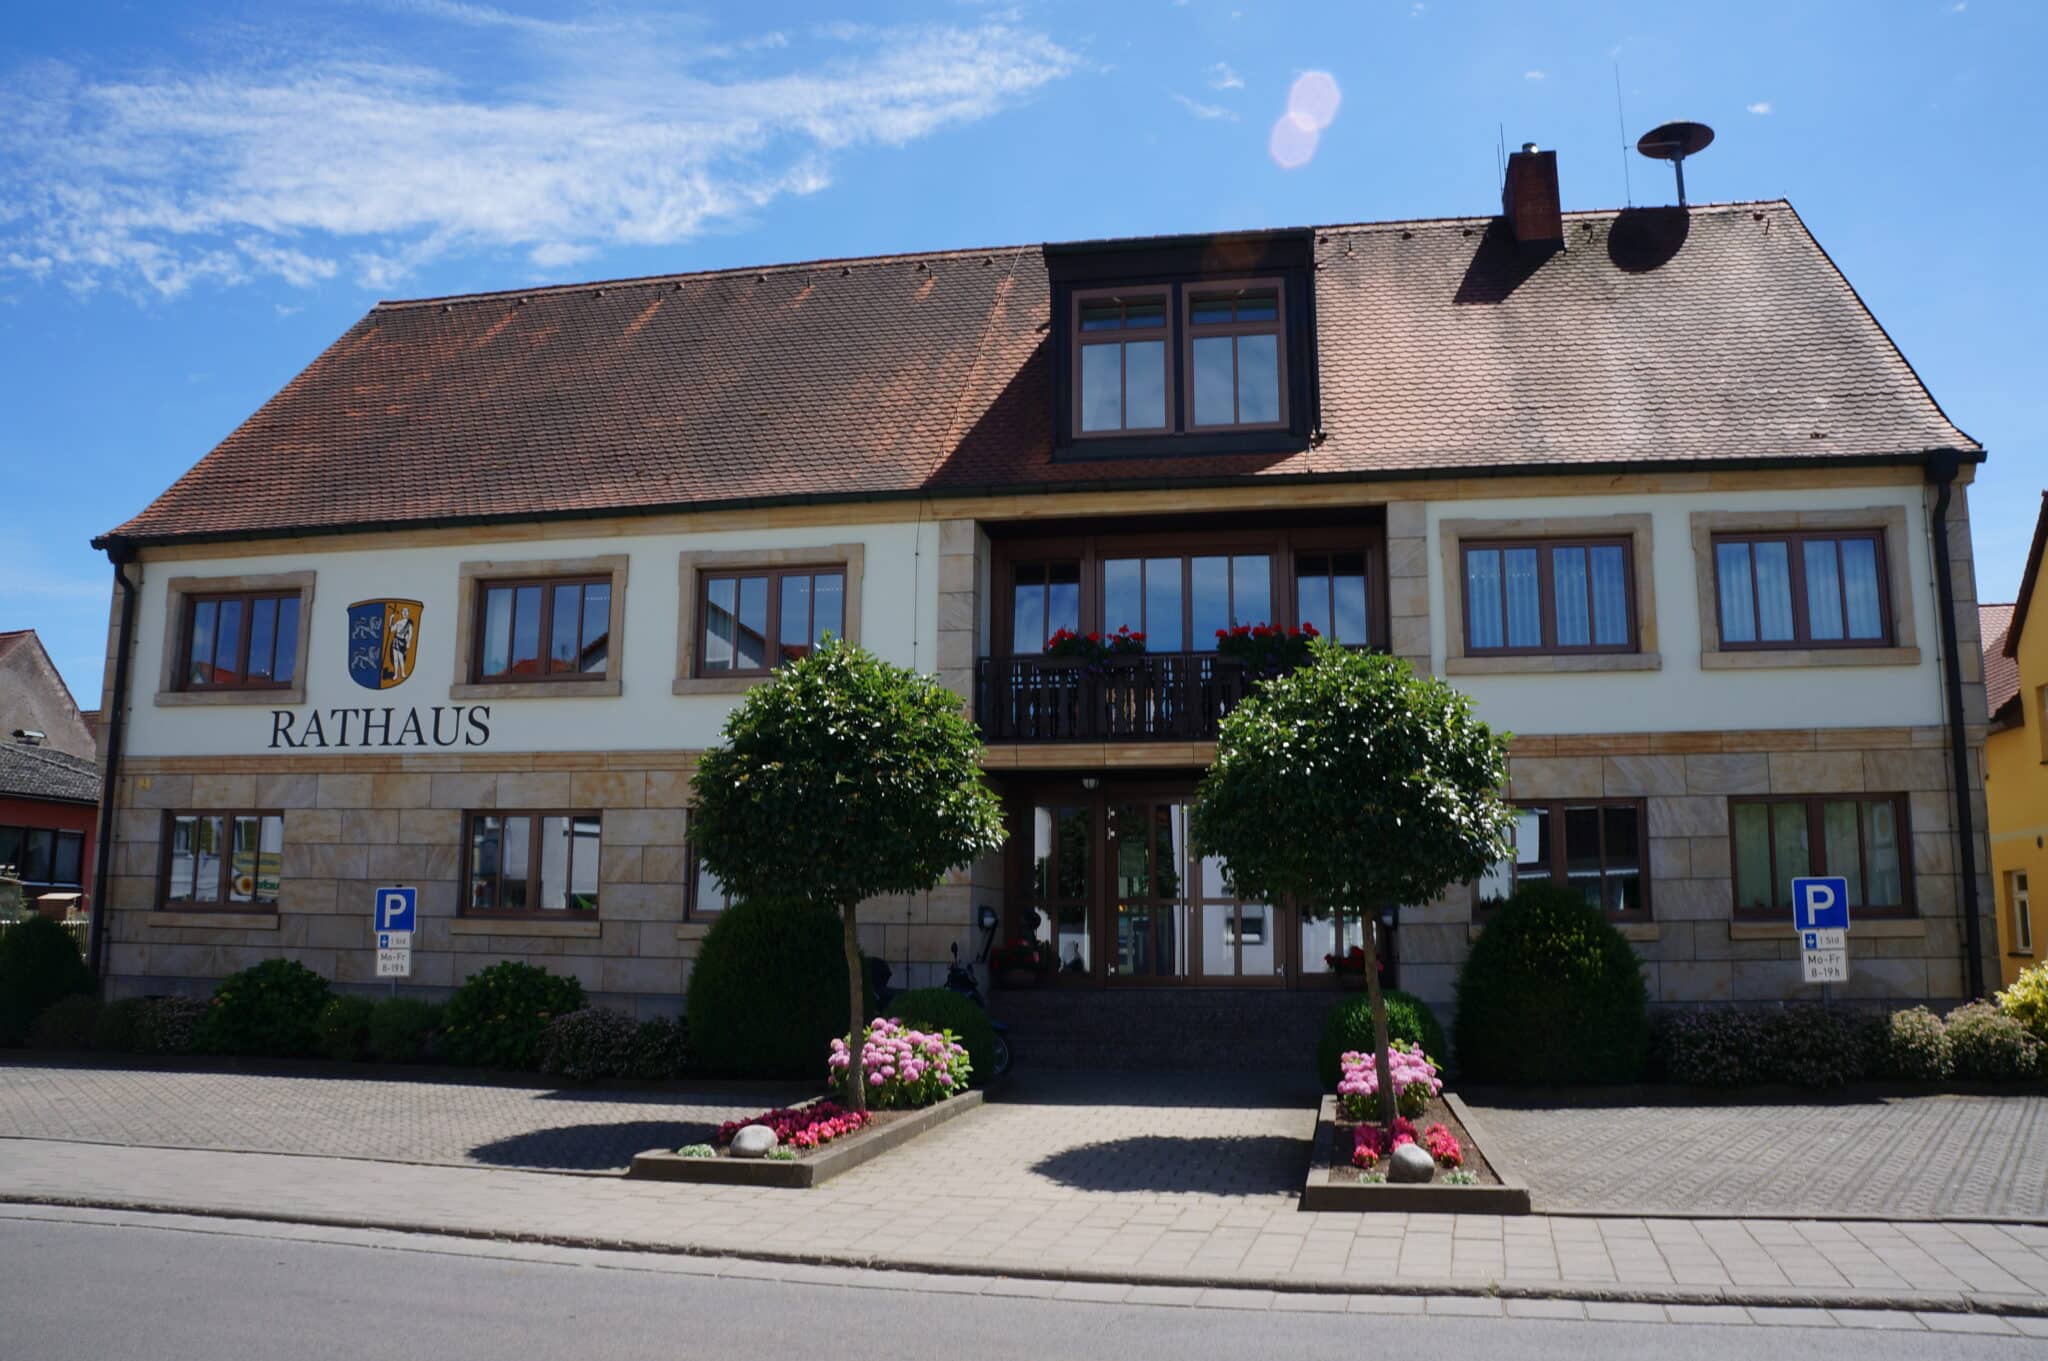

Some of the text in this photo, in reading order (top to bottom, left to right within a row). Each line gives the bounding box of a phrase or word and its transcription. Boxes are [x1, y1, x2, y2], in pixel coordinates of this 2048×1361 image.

[268, 705, 491, 748] RATHAUS
[384, 894, 407, 928] P
[1806, 884, 1835, 925] P
[1808, 952, 1841, 964] Mo-Fr
